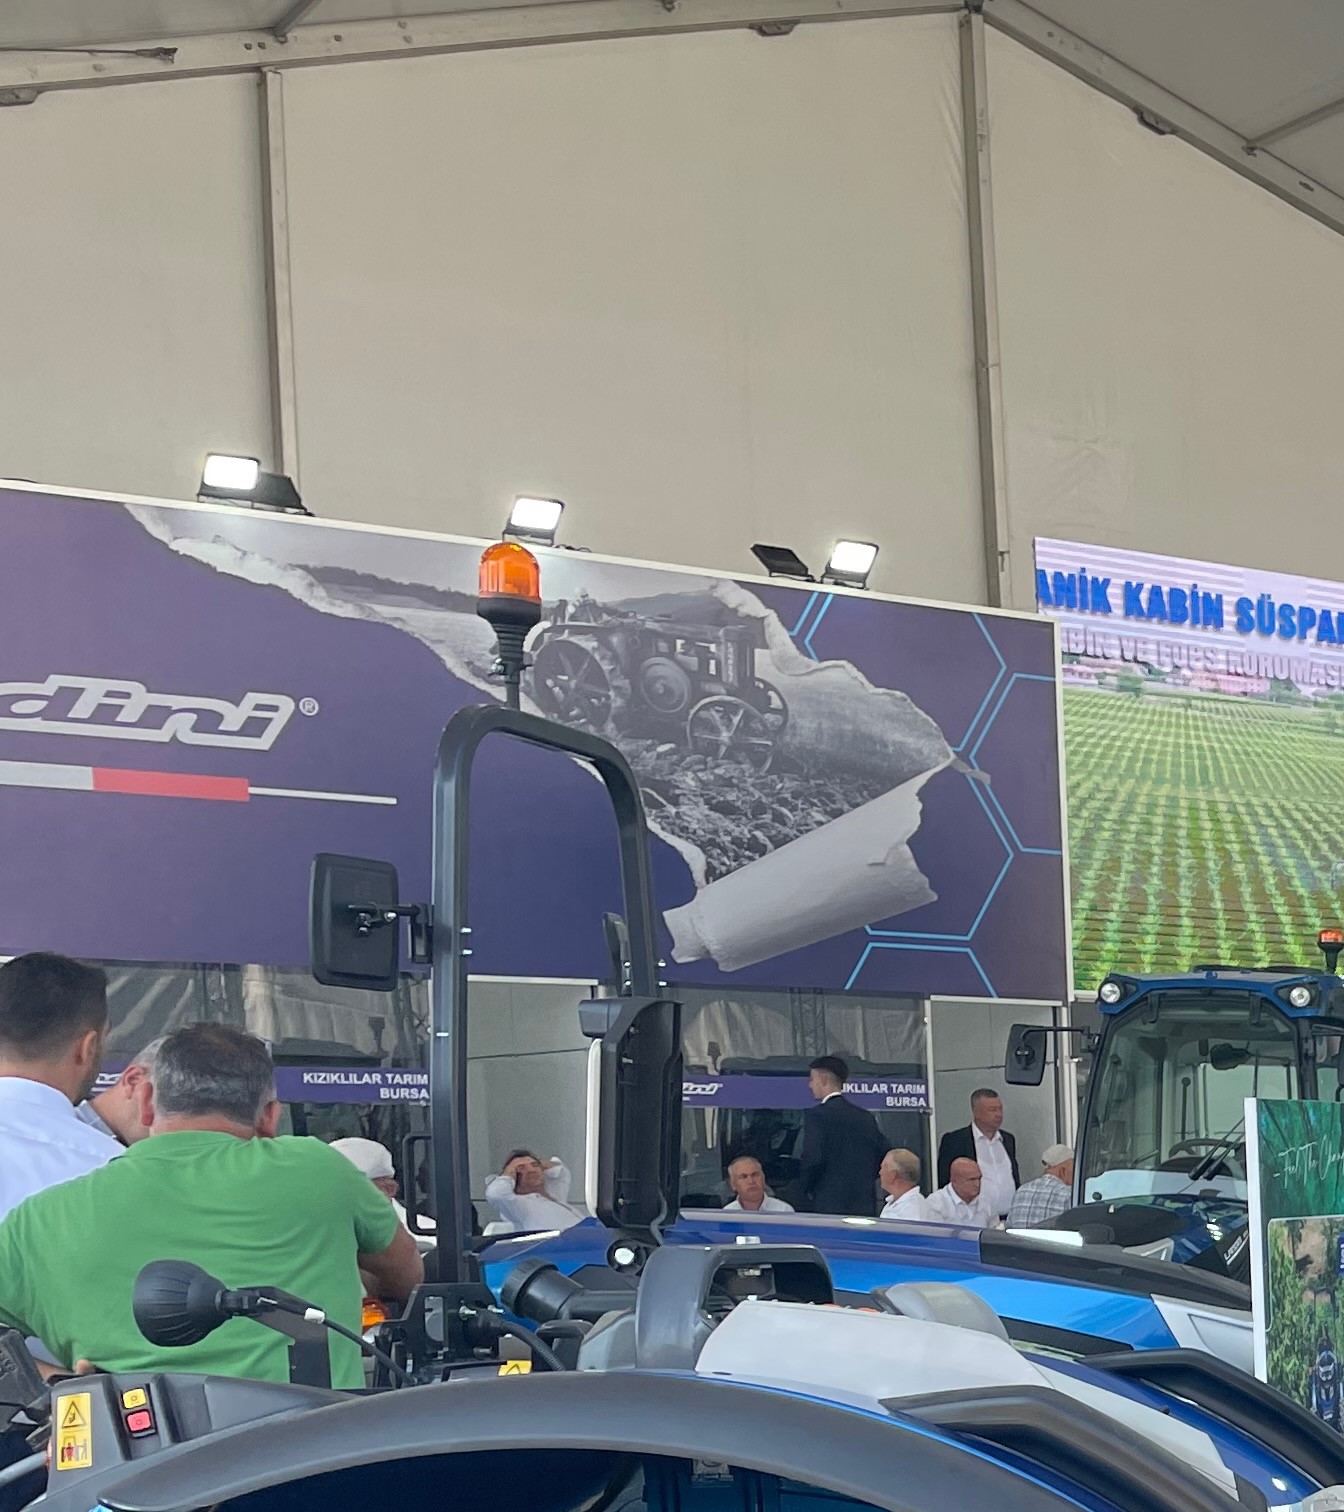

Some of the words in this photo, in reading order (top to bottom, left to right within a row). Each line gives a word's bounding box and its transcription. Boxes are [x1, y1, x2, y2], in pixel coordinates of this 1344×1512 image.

[1123, 580, 1225, 629] KABİN
[303, 1072, 382, 1085] KIZIKLILAR
[386, 1074, 429, 1085] TARIM
[379, 1087, 430, 1099] BURSA
[890, 1084, 926, 1094] TARIM
[886, 1096, 927, 1107] BURSA
